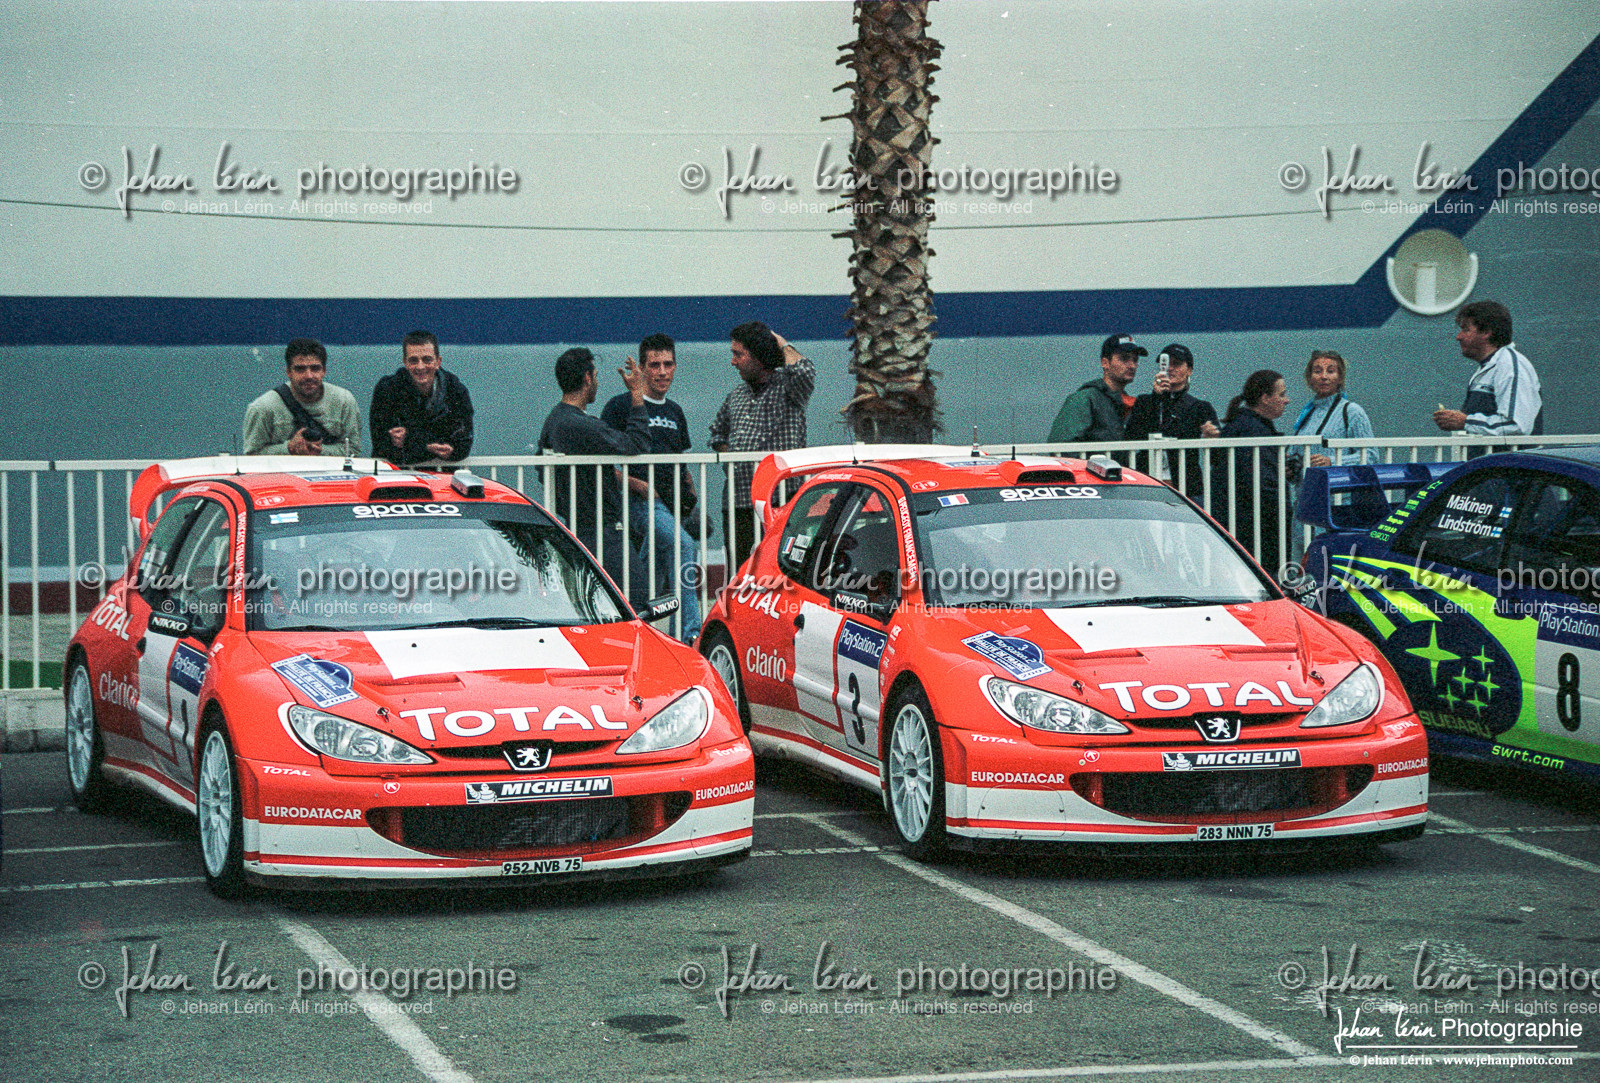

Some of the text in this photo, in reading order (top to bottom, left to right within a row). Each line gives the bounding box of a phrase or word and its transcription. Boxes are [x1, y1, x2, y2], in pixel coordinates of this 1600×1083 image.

[1000, 486, 1100, 502] sparco
[352, 502, 461, 519] sparco
[1446, 494, 1493, 515] Mäkinen
[1438, 514, 1491, 536] Lindström
[652, 599, 678, 615] NIKKO
[834, 593, 867, 609] NIKKO
[91, 594, 134, 641] TOTAL
[151, 617, 188, 632] NIKKO
[1017, 643, 1030, 652] 3
[746, 645, 787, 683] Clario
[1098, 680, 1315, 714] TOTAL
[1556, 652, 1581, 732] 8
[848, 672, 866, 745] 3
[399, 704, 629, 741] TOTAL
[1388, 719, 1419, 733] TOTAL
[1418, 710, 1493, 739] SUBARU
[971, 734, 1018, 744] TOTAL
[713, 744, 751, 757] TOTAL
[1195, 750, 1297, 766] MICHELIN
[1491, 745, 1565, 770] swrt.com
[262, 766, 311, 777] TOTAL
[1377, 757, 1428, 774] EURODATACAR
[971, 771, 1065, 784] EURODATACAR
[501, 778, 610, 796] MICHELIN
[695, 779, 754, 801] EURODATACAR
[264, 805, 362, 820] EURODATACAR
[1200, 824, 1272, 840] 283 NNN 75
[503, 858, 581, 875] 952 NVB 75
